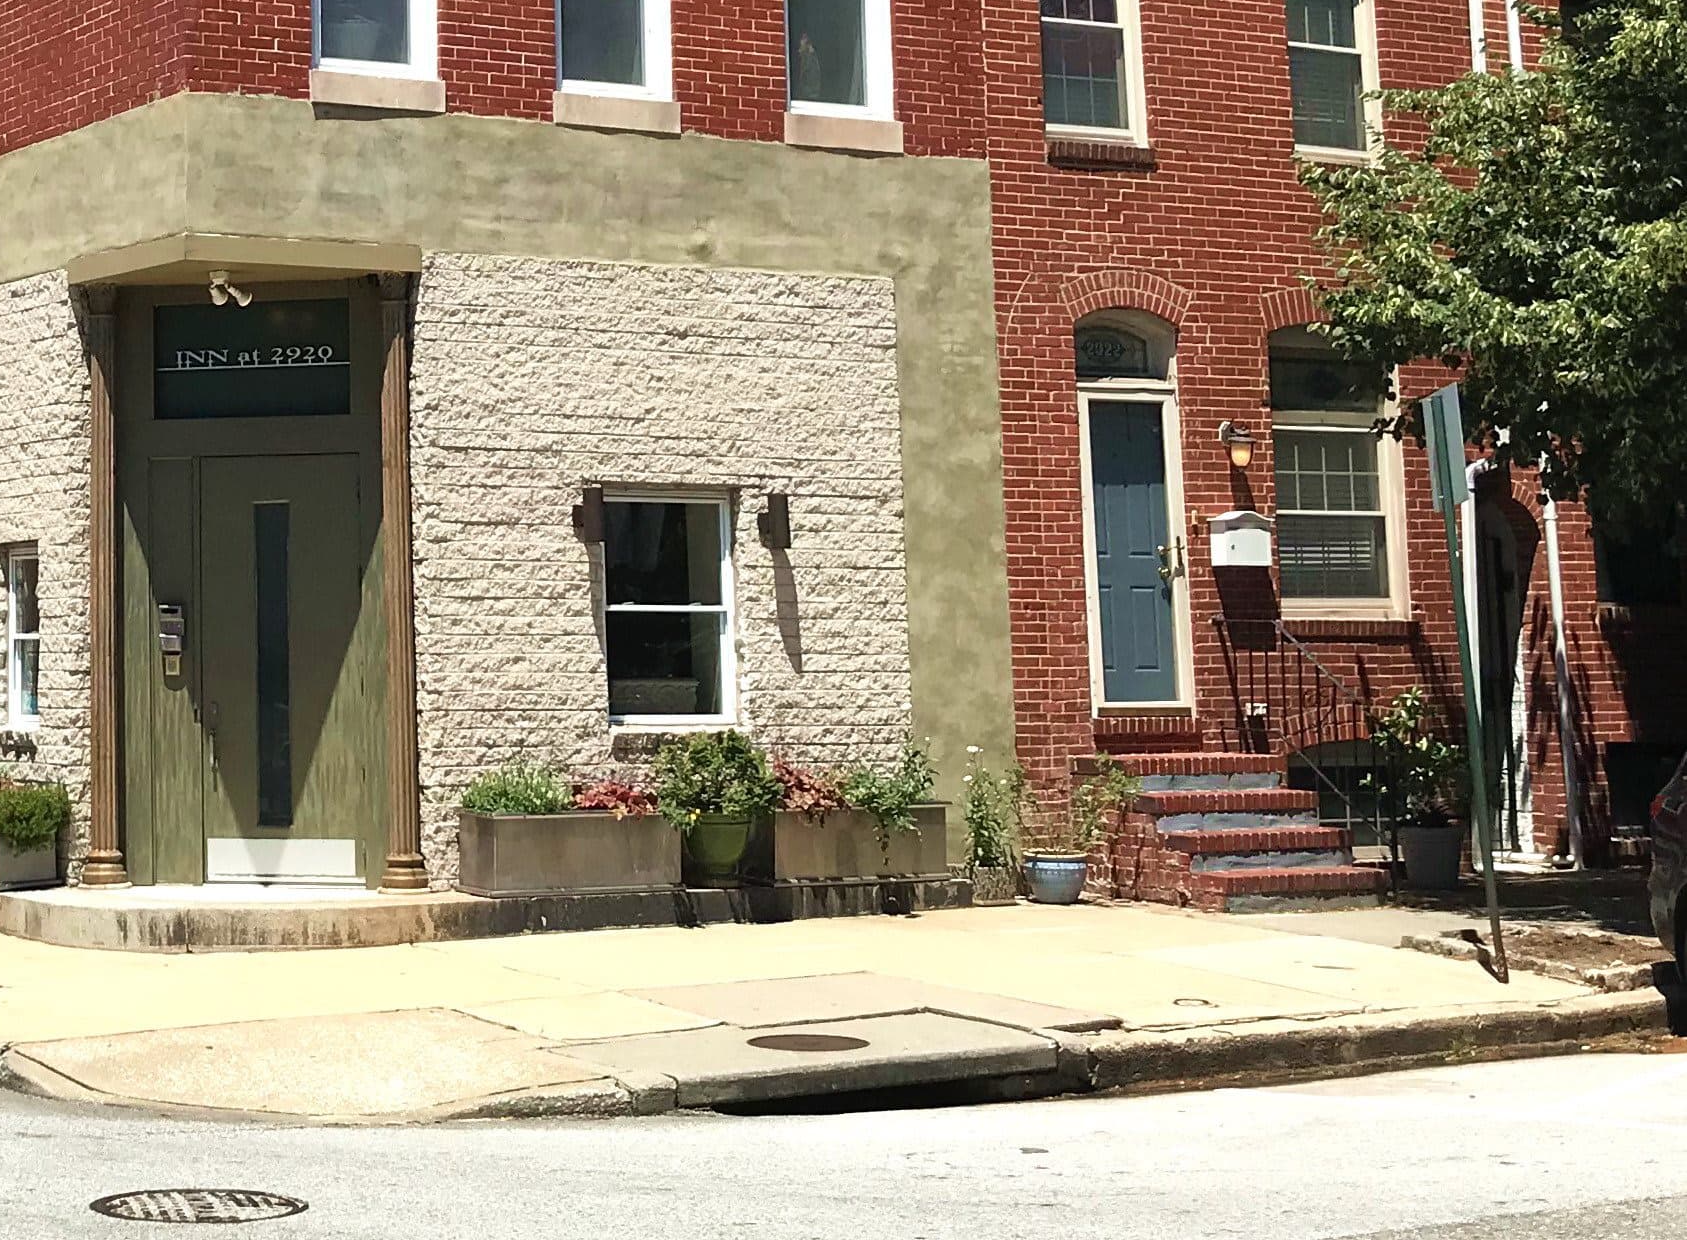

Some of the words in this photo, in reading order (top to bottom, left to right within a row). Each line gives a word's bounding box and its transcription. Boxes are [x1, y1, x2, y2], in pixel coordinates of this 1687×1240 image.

[176, 349, 229, 364] INN
[237, 348, 260, 361] at
[271, 345, 333, 361] 2920
